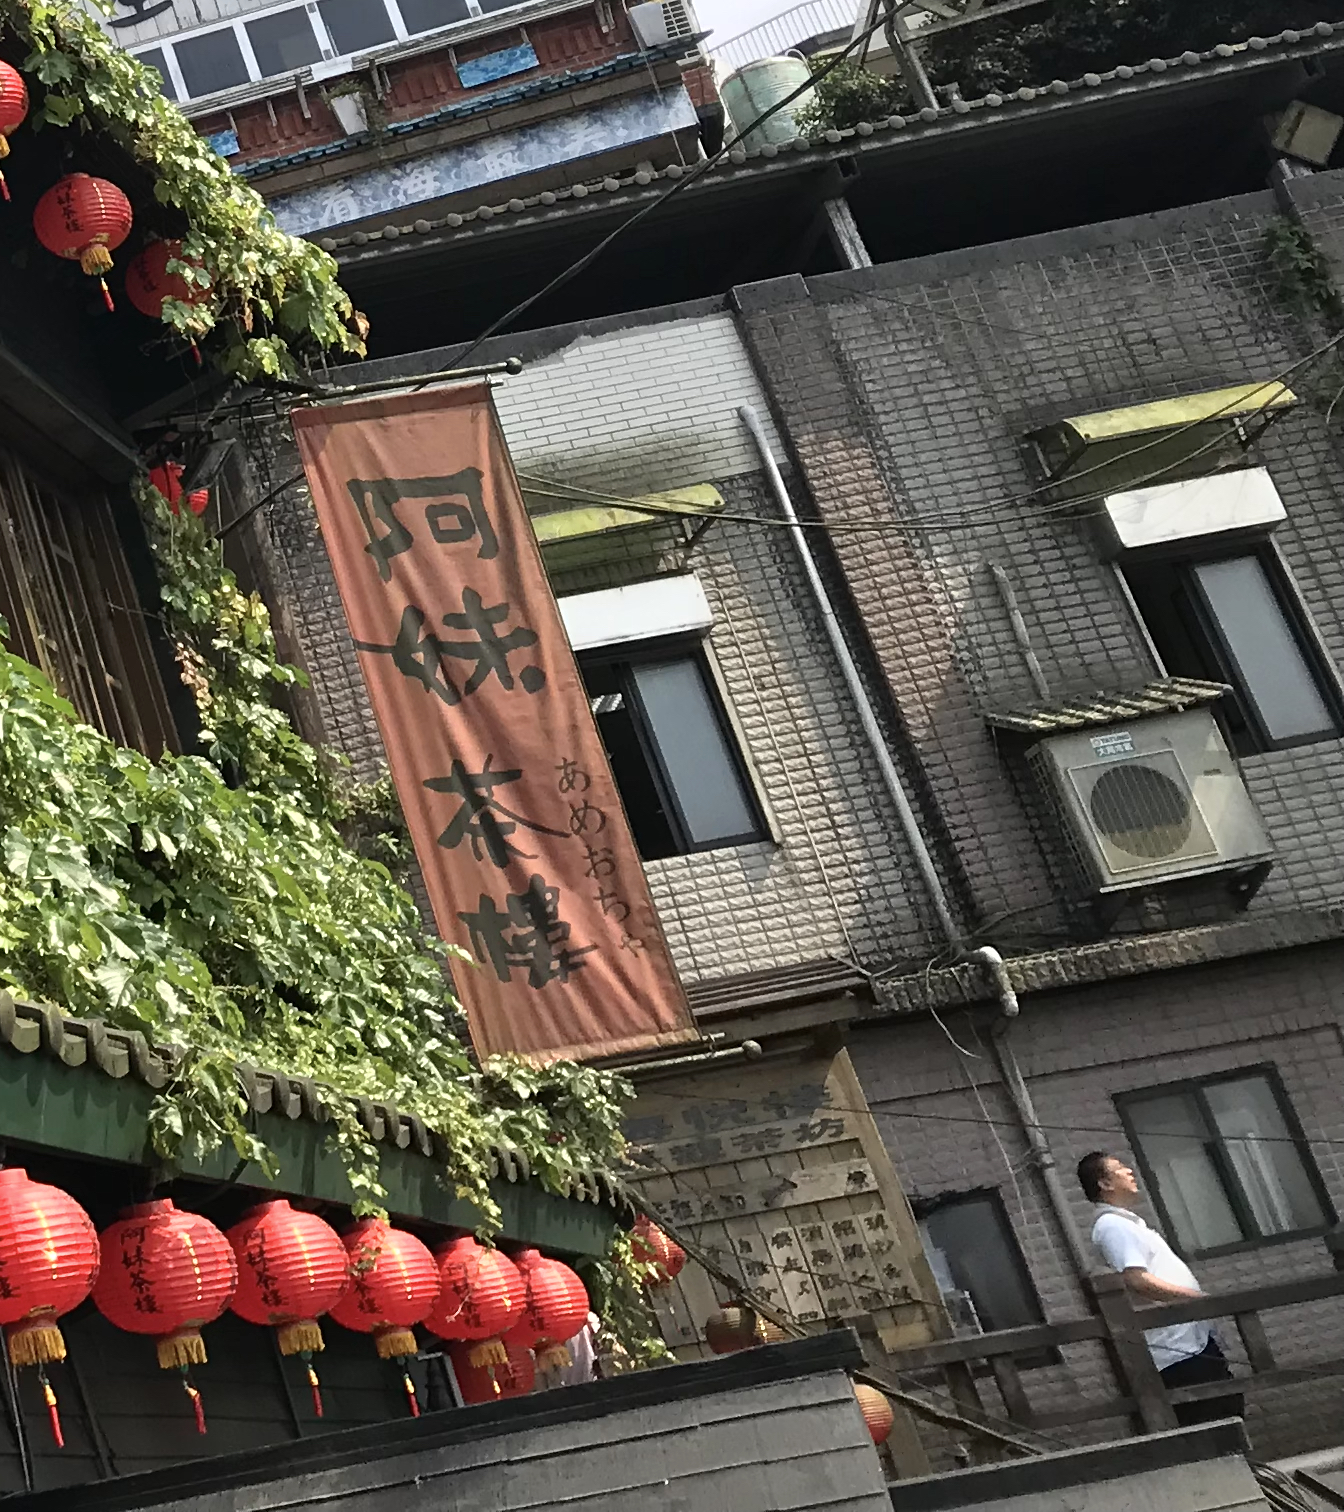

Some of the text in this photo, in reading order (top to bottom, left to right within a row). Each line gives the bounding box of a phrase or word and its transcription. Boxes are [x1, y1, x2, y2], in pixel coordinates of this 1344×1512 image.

[346, 467, 599, 989] 阿妹茶樓
[555, 755, 645, 959] あめおちゃ
[120, 1225, 162, 1314] 阿妹茶樓
